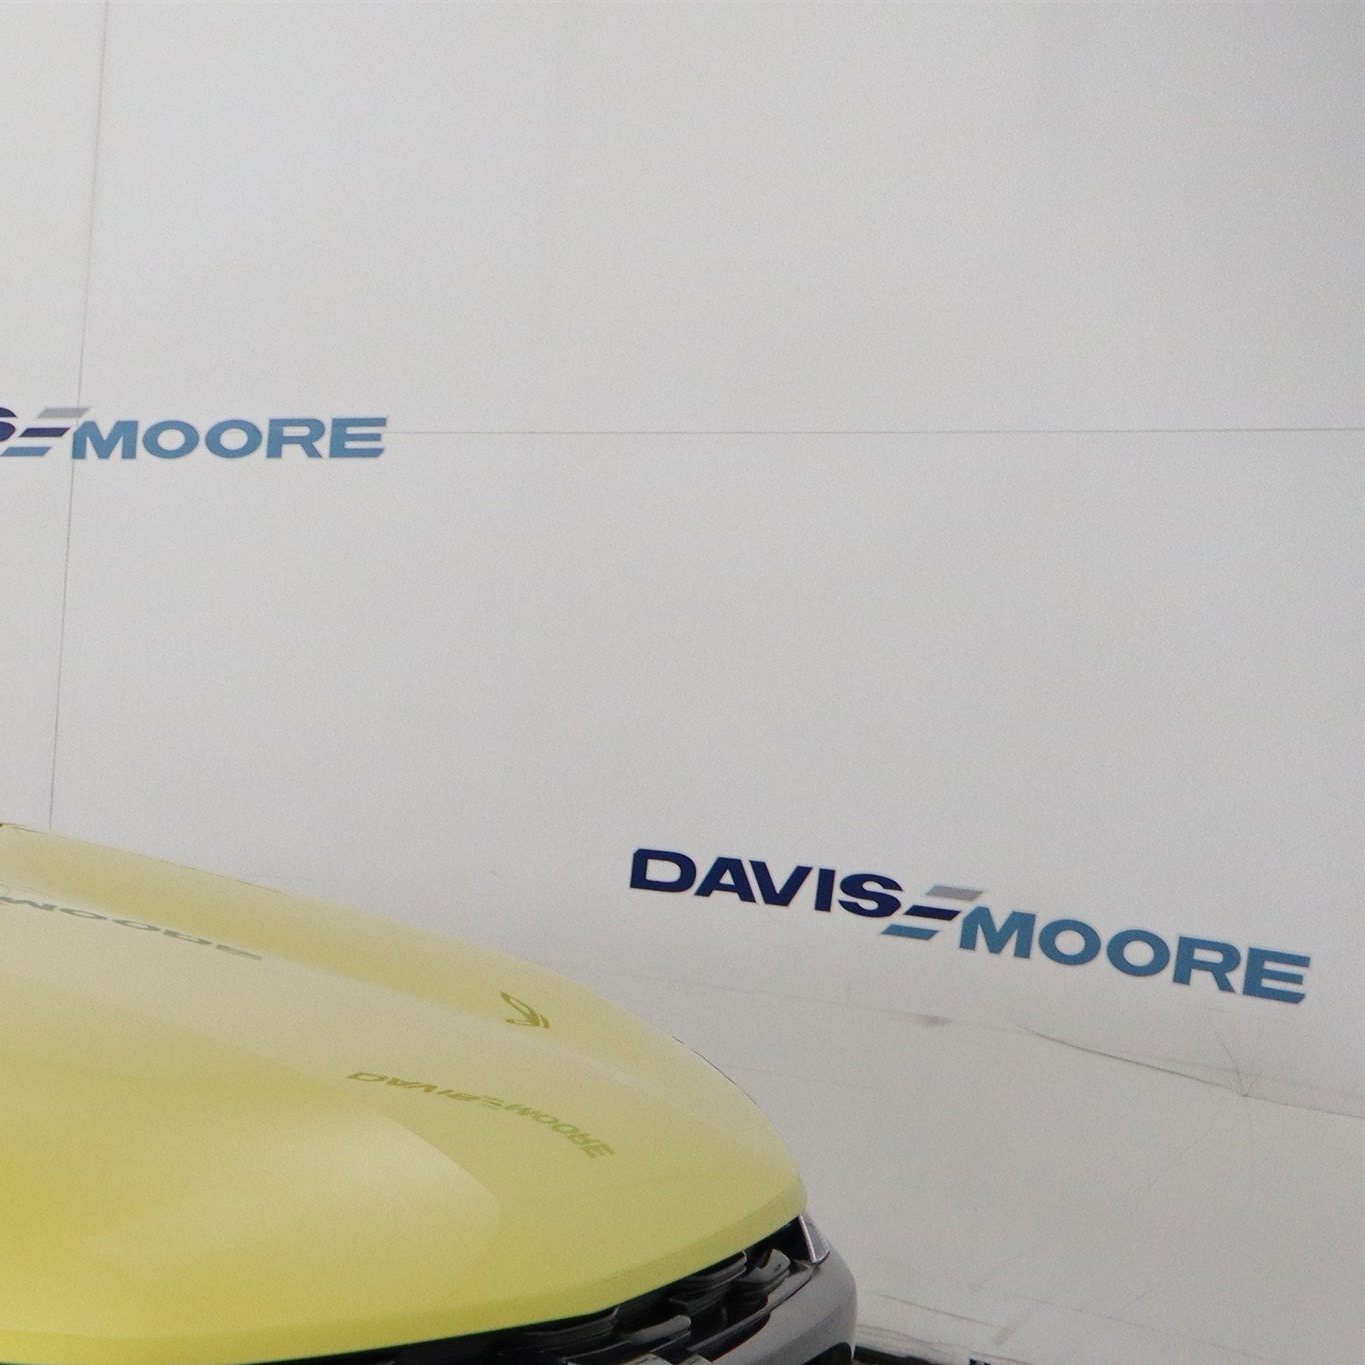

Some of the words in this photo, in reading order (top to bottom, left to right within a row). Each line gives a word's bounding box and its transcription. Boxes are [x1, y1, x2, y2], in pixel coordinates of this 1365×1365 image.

[72, 416, 388, 459] MOORE
[629, 847, 904, 919] DAVIS
[959, 905, 1311, 1004] MOORE
